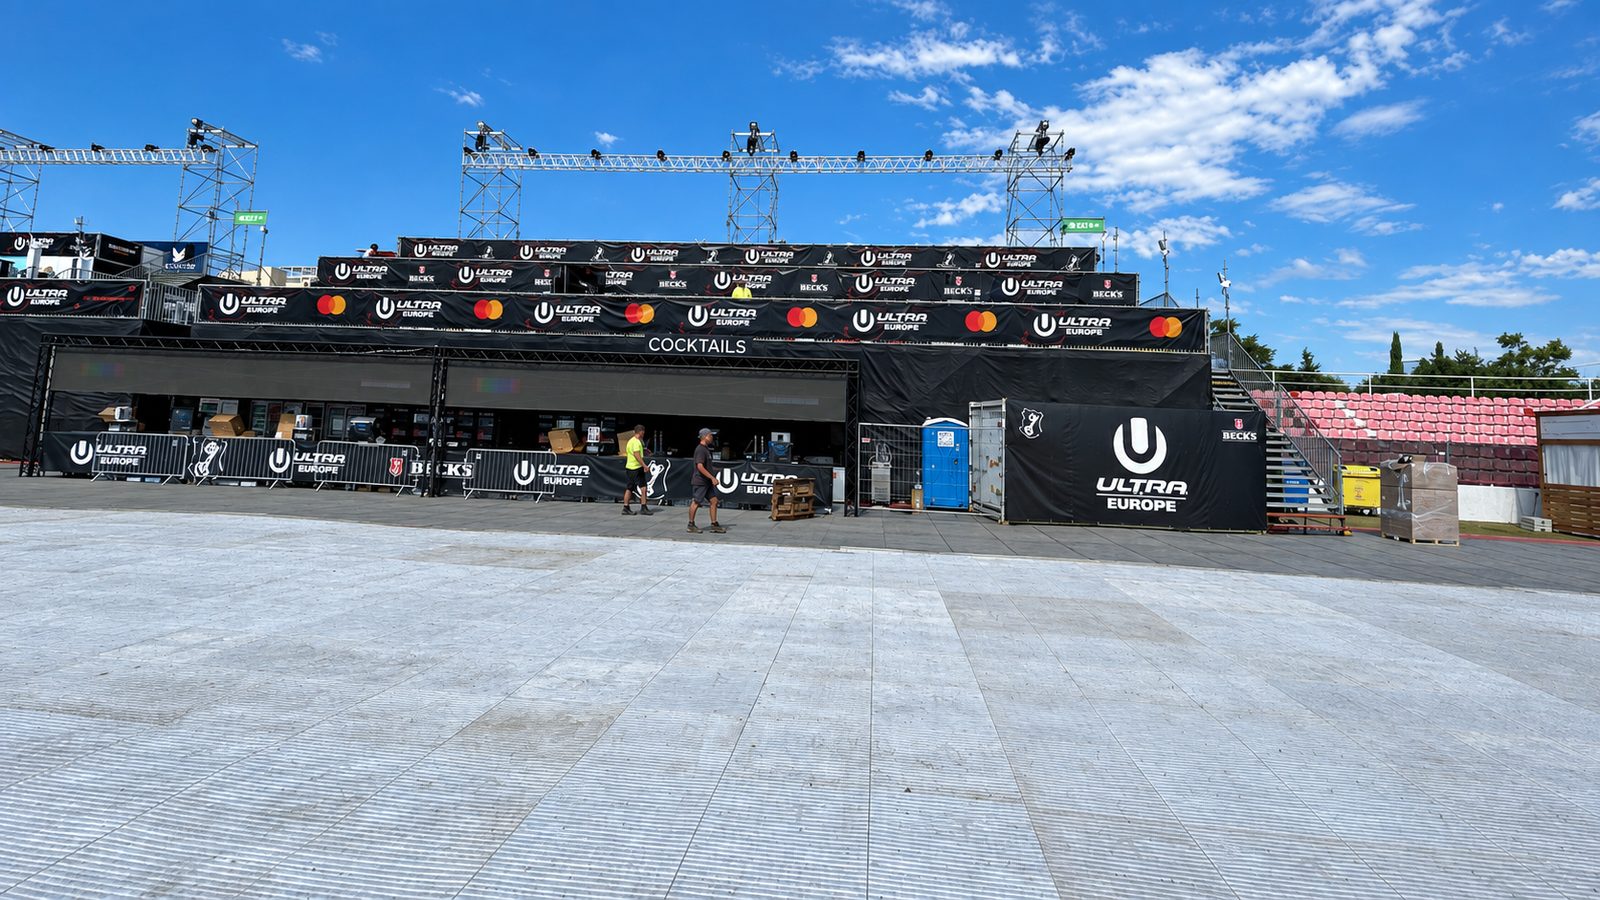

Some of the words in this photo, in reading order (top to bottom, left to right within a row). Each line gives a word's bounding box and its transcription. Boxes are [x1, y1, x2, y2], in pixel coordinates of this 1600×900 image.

[475, 268, 513, 276] ULTRA
[732, 274, 772, 282] ULTRA
[875, 277, 916, 285] ULTRA
[1021, 280, 1063, 288] ULTRA
[25, 289, 68, 297] ULTRA
[241, 296, 287, 305] ULTRA
[396, 300, 442, 309] ULTRA
[247, 306, 278, 314] EUROPE
[555, 305, 601, 314] ULTRA
[710, 308, 757, 317] ULTRA
[877, 312, 928, 322] ULTRA
[1058, 317, 1112, 326] ULTRA
[1066, 328, 1103, 336] EUROPE
[648, 337, 746, 353] COCKTAILS
[96, 444, 147, 455] ULTRA
[100, 457, 139, 466] EUROPE
[294, 452, 346, 463] ULTRA
[298, 465, 338, 474] EUROPE
[538, 464, 590, 475] ULTRA
[1096, 477, 1188, 495] ULTRA
[1107, 498, 1176, 512] EUROPE
